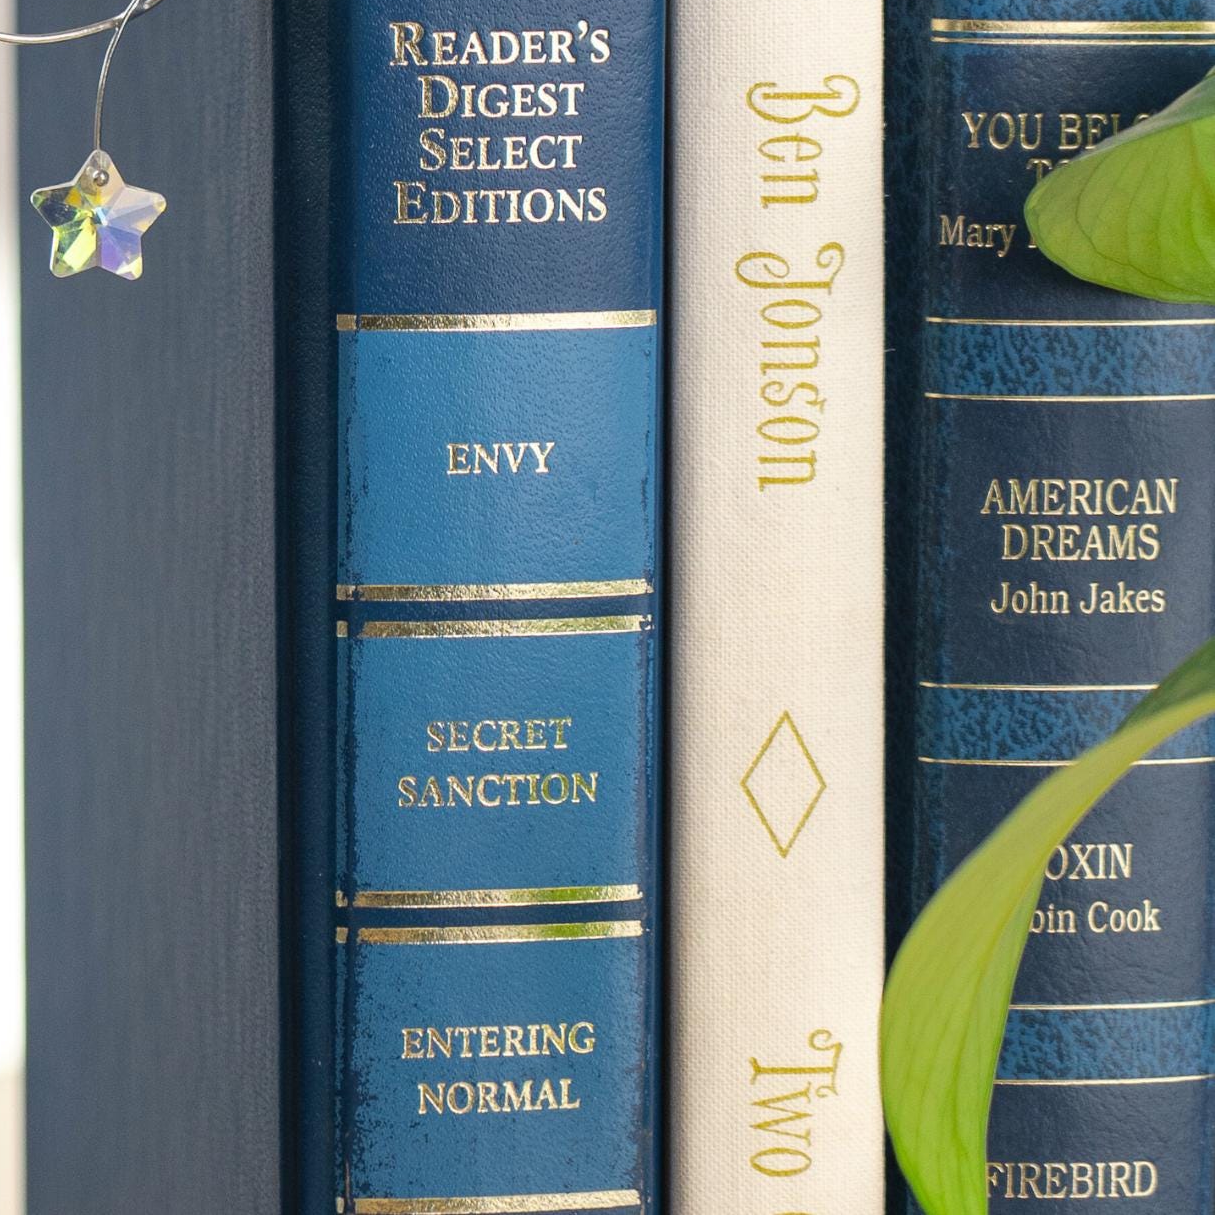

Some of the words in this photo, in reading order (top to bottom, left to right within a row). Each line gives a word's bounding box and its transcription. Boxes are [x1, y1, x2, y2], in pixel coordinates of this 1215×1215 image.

[389, 19, 611, 67] READER'S
[417, 74, 585, 119] DIGEST
[418, 126, 583, 172] SELECT
[746, 74, 861, 209] Ben
[961, 111, 1044, 150] YOU
[393, 181, 608, 225] EDITIONS
[938, 214, 1017, 258] Mary
[734, 241, 846, 493] Jonson
[446, 441, 555, 476] ENVY
[980, 477, 1179, 516] AMERICAN
[1001, 523, 1161, 561] DREAMS
[990, 581, 1071, 615] John
[1079, 581, 1167, 615] Jakes
[426, 717, 572, 753] SECRET
[397, 772, 599, 809] SANCTION
[1044, 843, 1134, 881] OXIN
[1087, 898, 1162, 934] Cook
[400, 1021, 597, 1060] ENTERING
[417, 1078, 582, 1115] NORMAL
[749, 1028, 844, 1177] Two
[985, 1161, 1159, 1199] FIREBIRD
